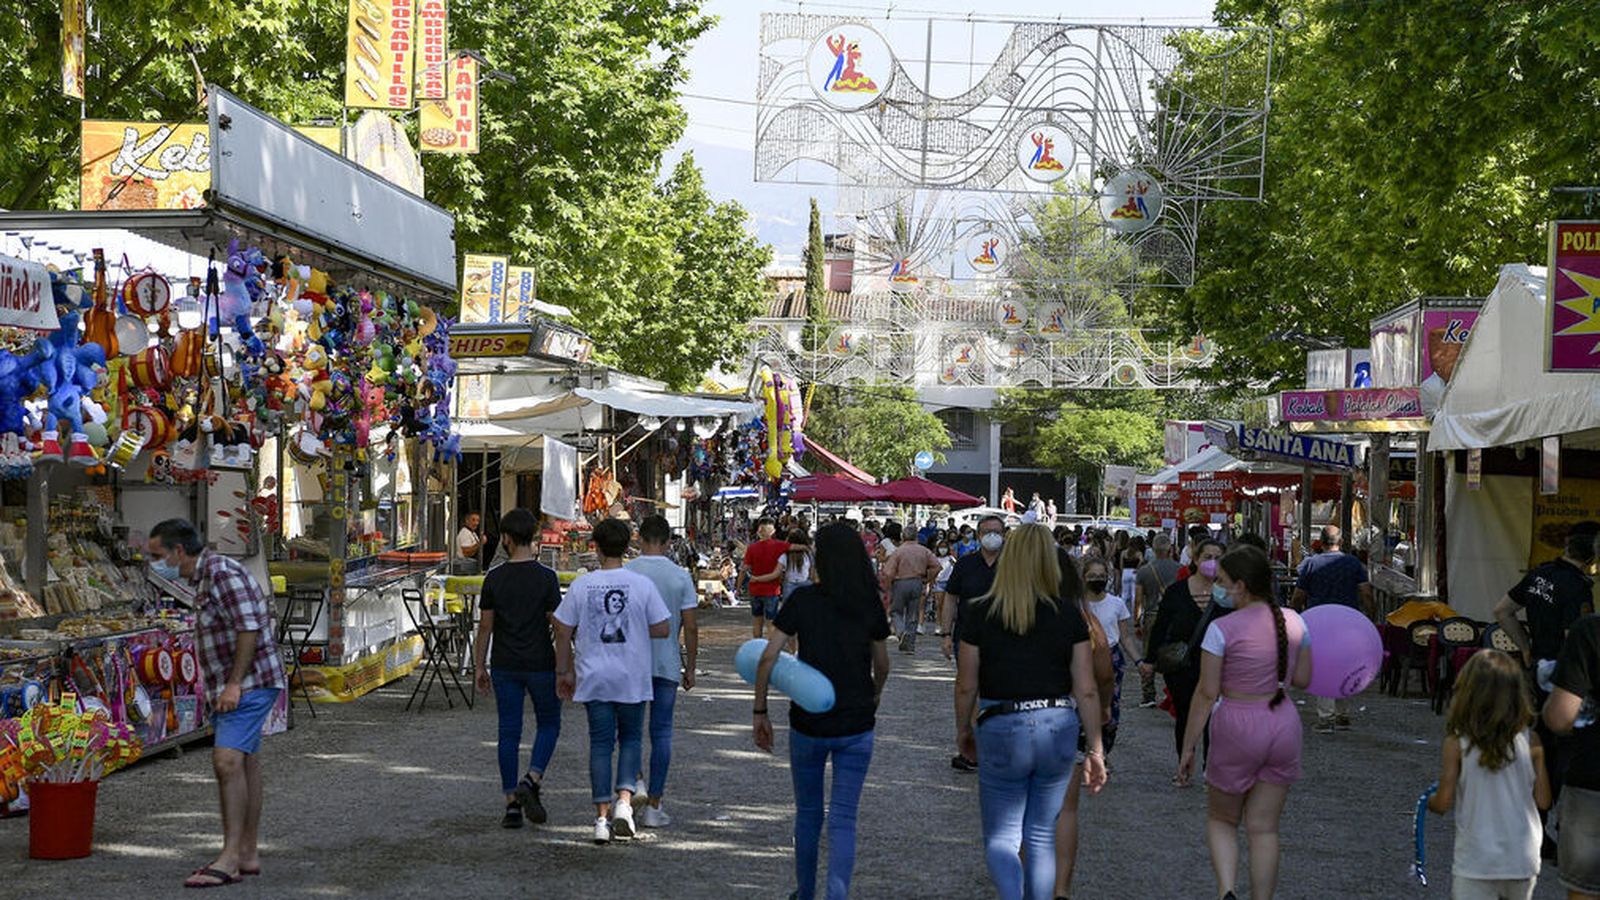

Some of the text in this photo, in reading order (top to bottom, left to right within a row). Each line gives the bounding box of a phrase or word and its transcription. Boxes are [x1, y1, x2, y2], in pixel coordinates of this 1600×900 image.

[388, 0, 411, 107] BOCADILLOS
[455, 55, 472, 148] PANINI
[1287, 396, 1325, 416] Kebab
[1243, 430, 1350, 465] SANTA ANA
